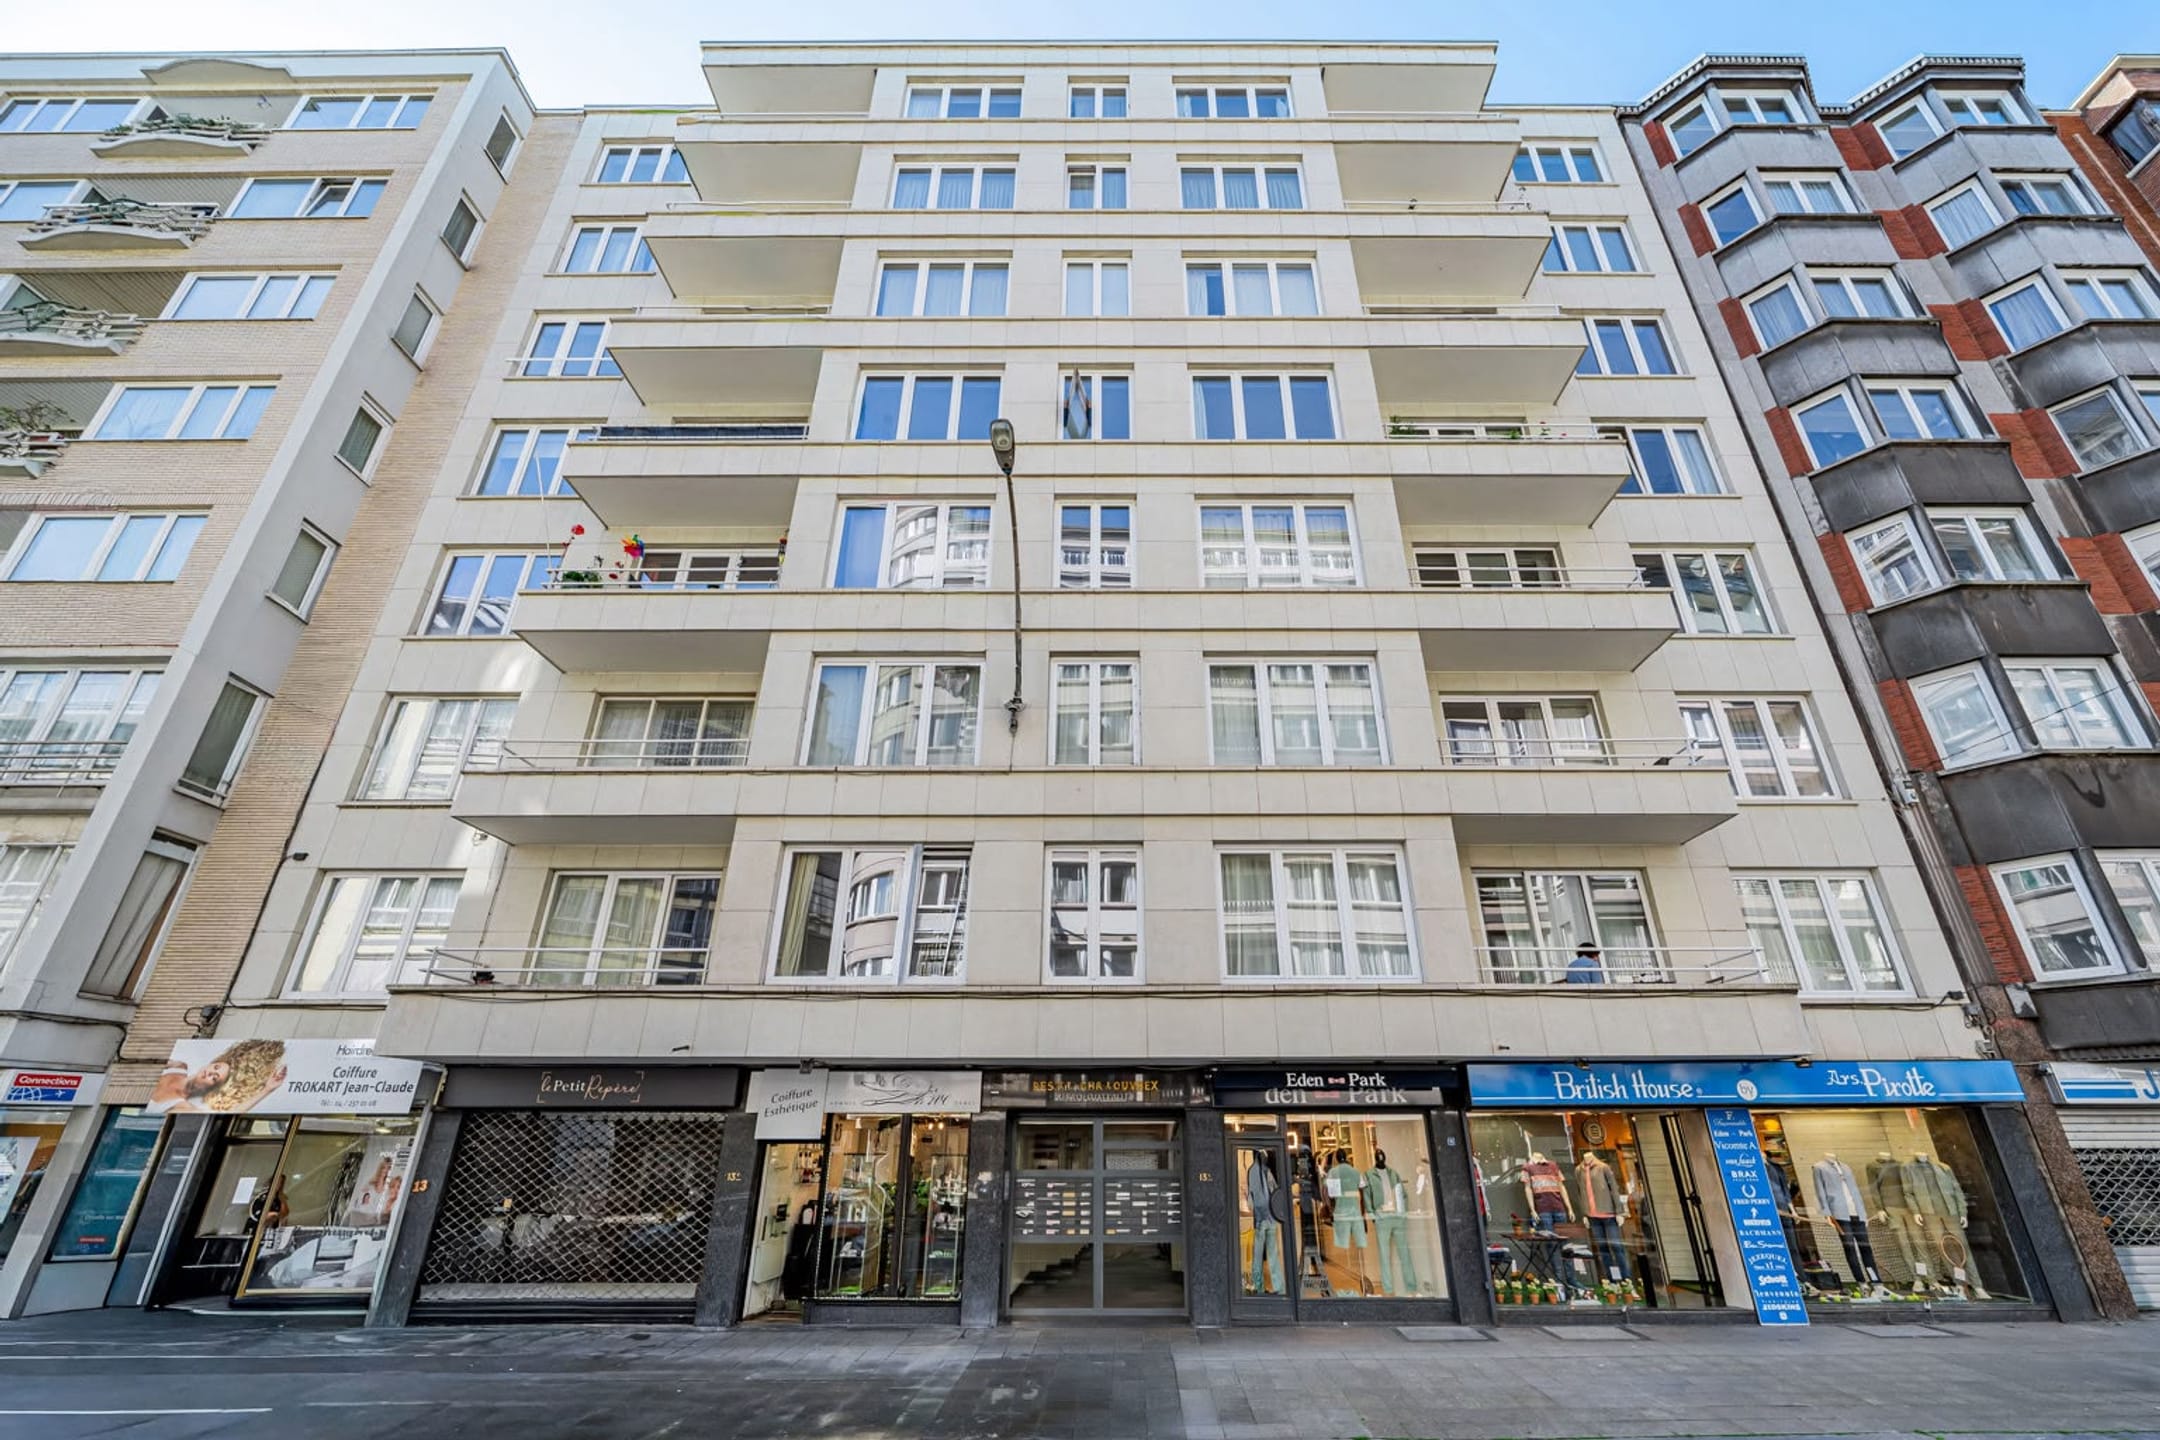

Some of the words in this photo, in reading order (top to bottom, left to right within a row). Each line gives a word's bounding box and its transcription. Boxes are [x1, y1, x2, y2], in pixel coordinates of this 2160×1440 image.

[332, 1066, 378, 1079] Coiffure
[1286, 1072, 1324, 1087] Eden
[1348, 1072, 1387, 1087] Park
[19, 1075, 79, 1086] Connections
[553, 1079, 585, 1092] Petit
[1553, 1071, 1629, 1100] British
[1632, 1069, 1694, 1099] House
[1859, 1066, 1937, 1097] Pirotte
[288, 1081, 342, 1093] TROKART
[342, 1081, 414, 1096] Jean-Claude
[770, 1087, 814, 1104] Coiffure
[764, 1099, 819, 1118] Esthétique
[1731, 1170, 1758, 1178] BRAX
[411, 1179, 429, 1193] 13
